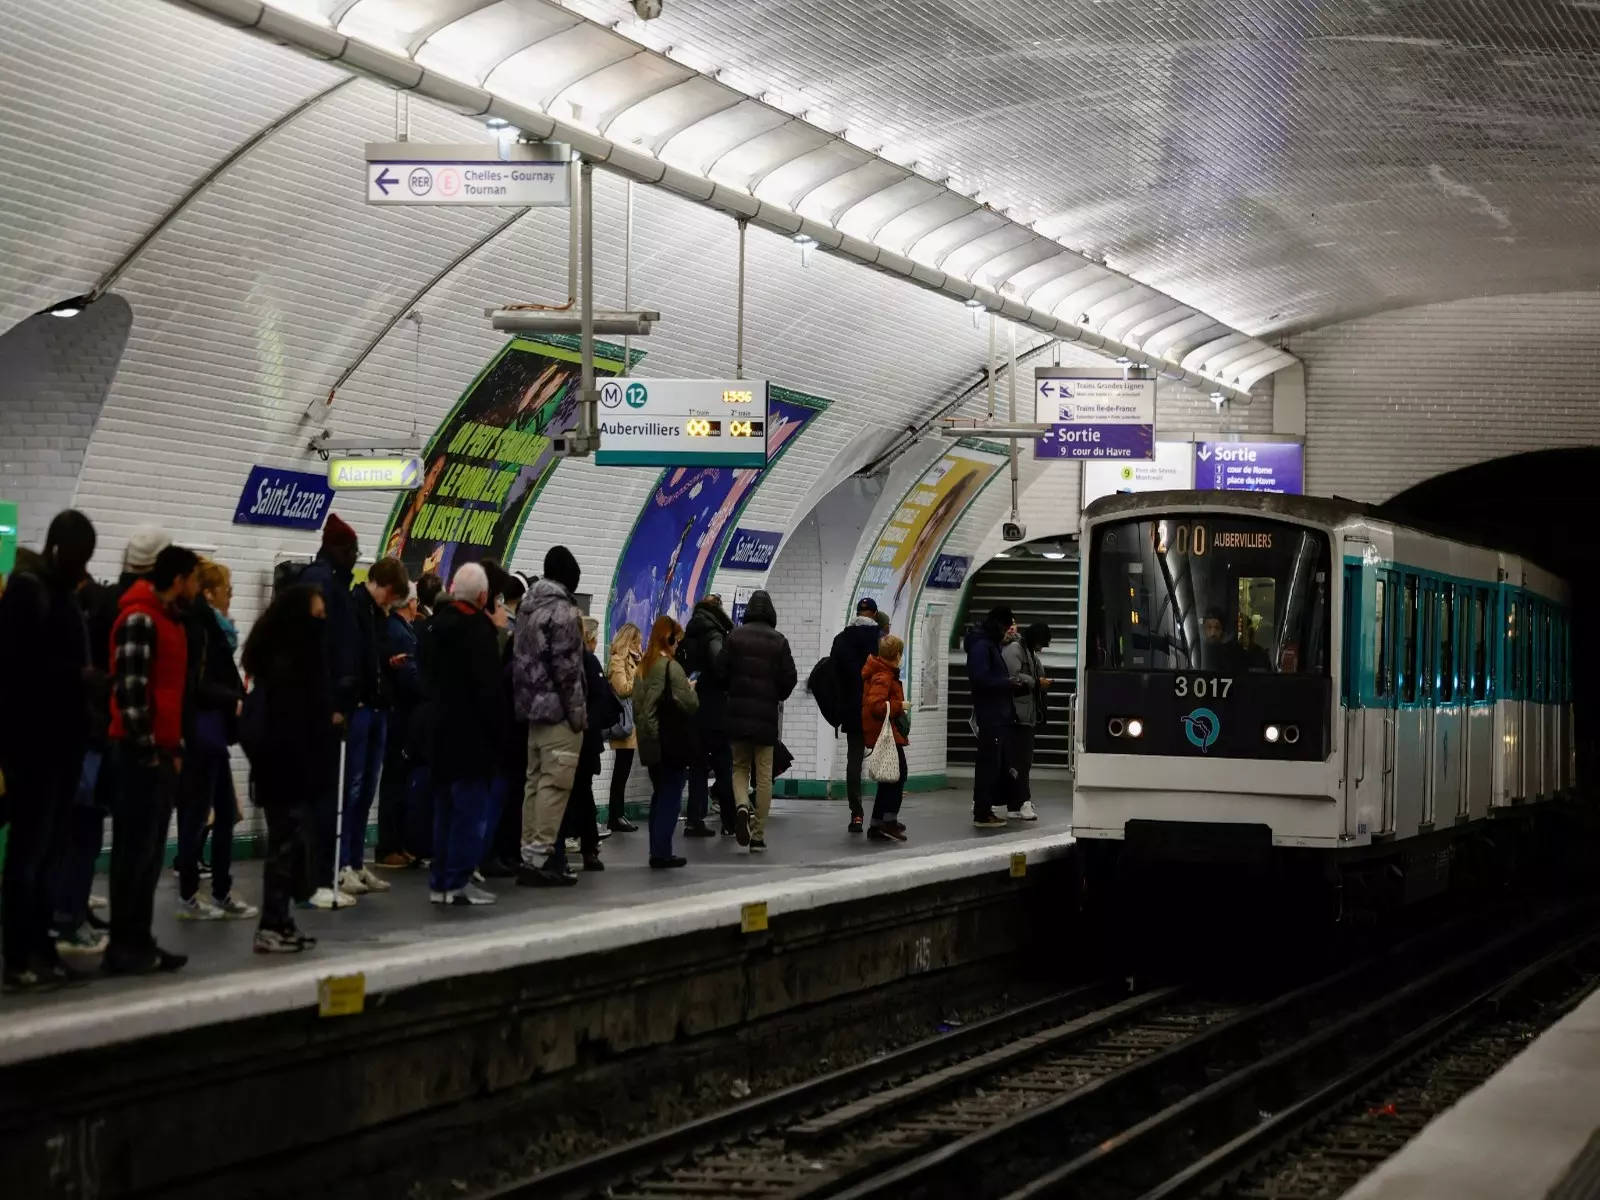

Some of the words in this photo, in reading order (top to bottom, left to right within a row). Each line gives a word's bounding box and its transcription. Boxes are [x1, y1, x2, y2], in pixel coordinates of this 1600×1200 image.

[411, 177, 430, 188] RER
[464, 170, 501, 181] Chelles
[511, 171, 555, 183] Gournay
[464, 184, 507, 195] Tournan
[605, 388, 617, 402] M
[627, 388, 645, 404] 12
[600, 422, 680, 437] Aubervilliers
[730, 420, 752, 436] 04
[1058, 427, 1101, 442] Sortie
[1060, 447, 1067, 455] 9
[1072, 448, 1091, 456] cour
[1093, 446, 1104, 456] du
[1106, 447, 1131, 457] Havre
[1214, 448, 1257, 462] Sortie
[337, 466, 393, 482] Alarme
[1226, 466, 1242, 474] cour
[1243, 466, 1252, 474] de
[1253, 466, 1273, 474] Rome
[1226, 476, 1244, 485] place
[1245, 476, 1255, 484] du
[1255, 477, 1275, 485] Havre
[250, 477, 325, 520] Saint-Lazare
[1214, 532, 1272, 548] AUBERVILLIERS
